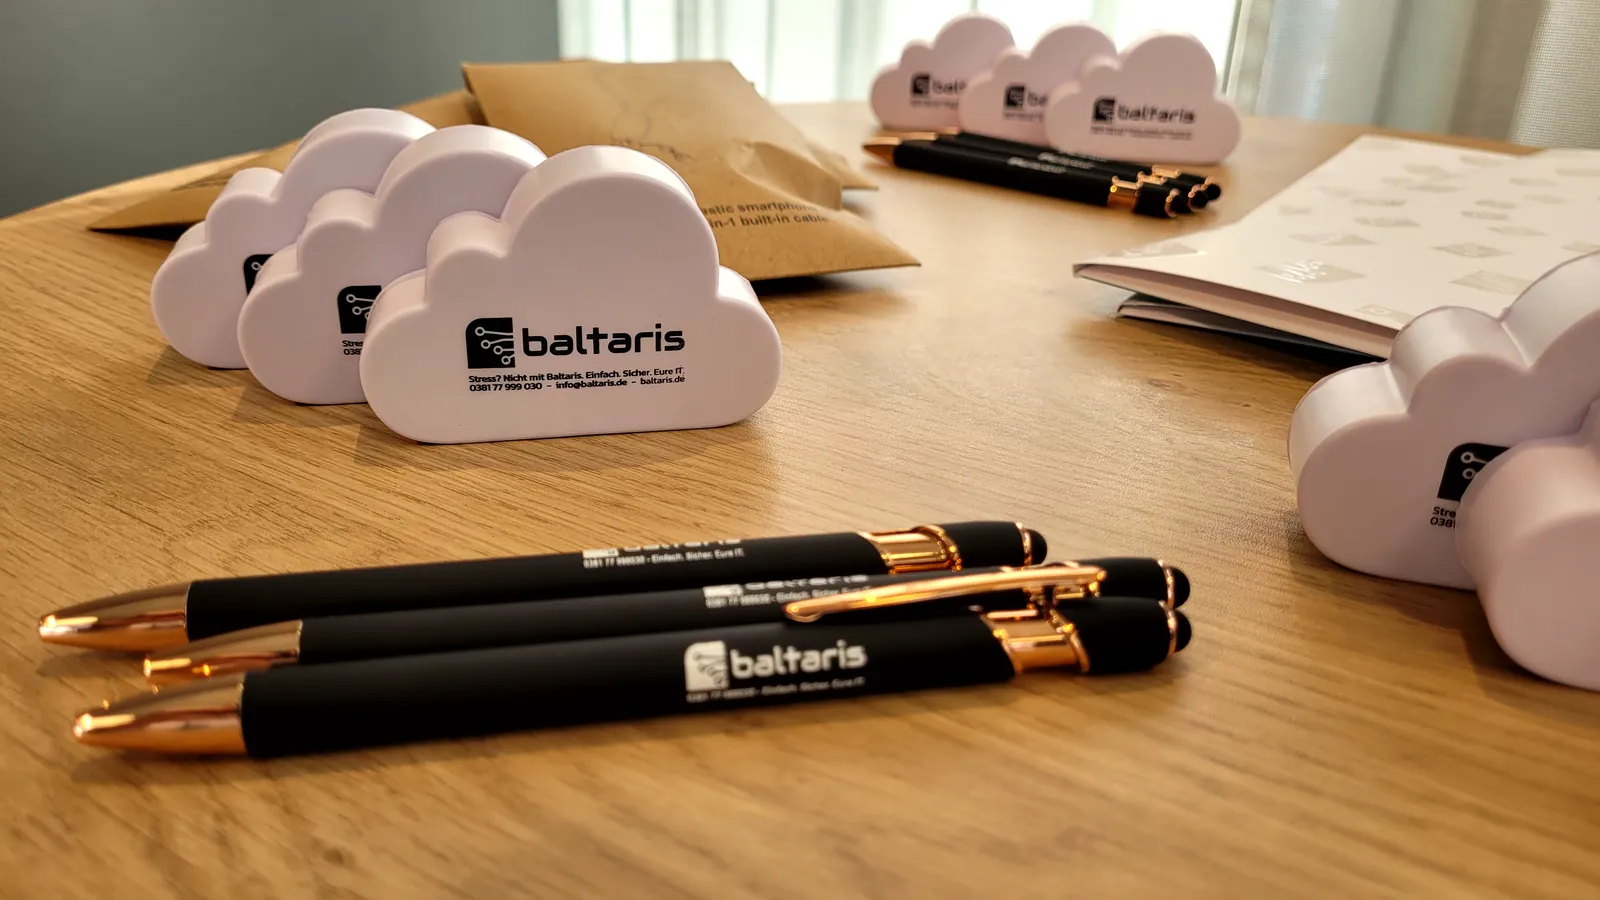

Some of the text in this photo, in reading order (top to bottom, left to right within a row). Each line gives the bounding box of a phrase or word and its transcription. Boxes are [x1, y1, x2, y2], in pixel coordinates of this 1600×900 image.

[738, 214, 790, 226] built-in
[522, 323, 685, 357] baltaris
[468, 374, 502, 383] Stress?
[504, 374, 528, 382] Nicht
[546, 372, 584, 380] Baltaris.
[586, 370, 621, 379] Einfach.
[622, 368, 652, 378] Sicher.
[654, 368, 673, 376] Eure
[676, 367, 685, 375] IT.
[556, 379, 628, 389] info@baltaris.de
[640, 376, 685, 385] baltaris.de
[730, 639, 868, 680] baltaris
